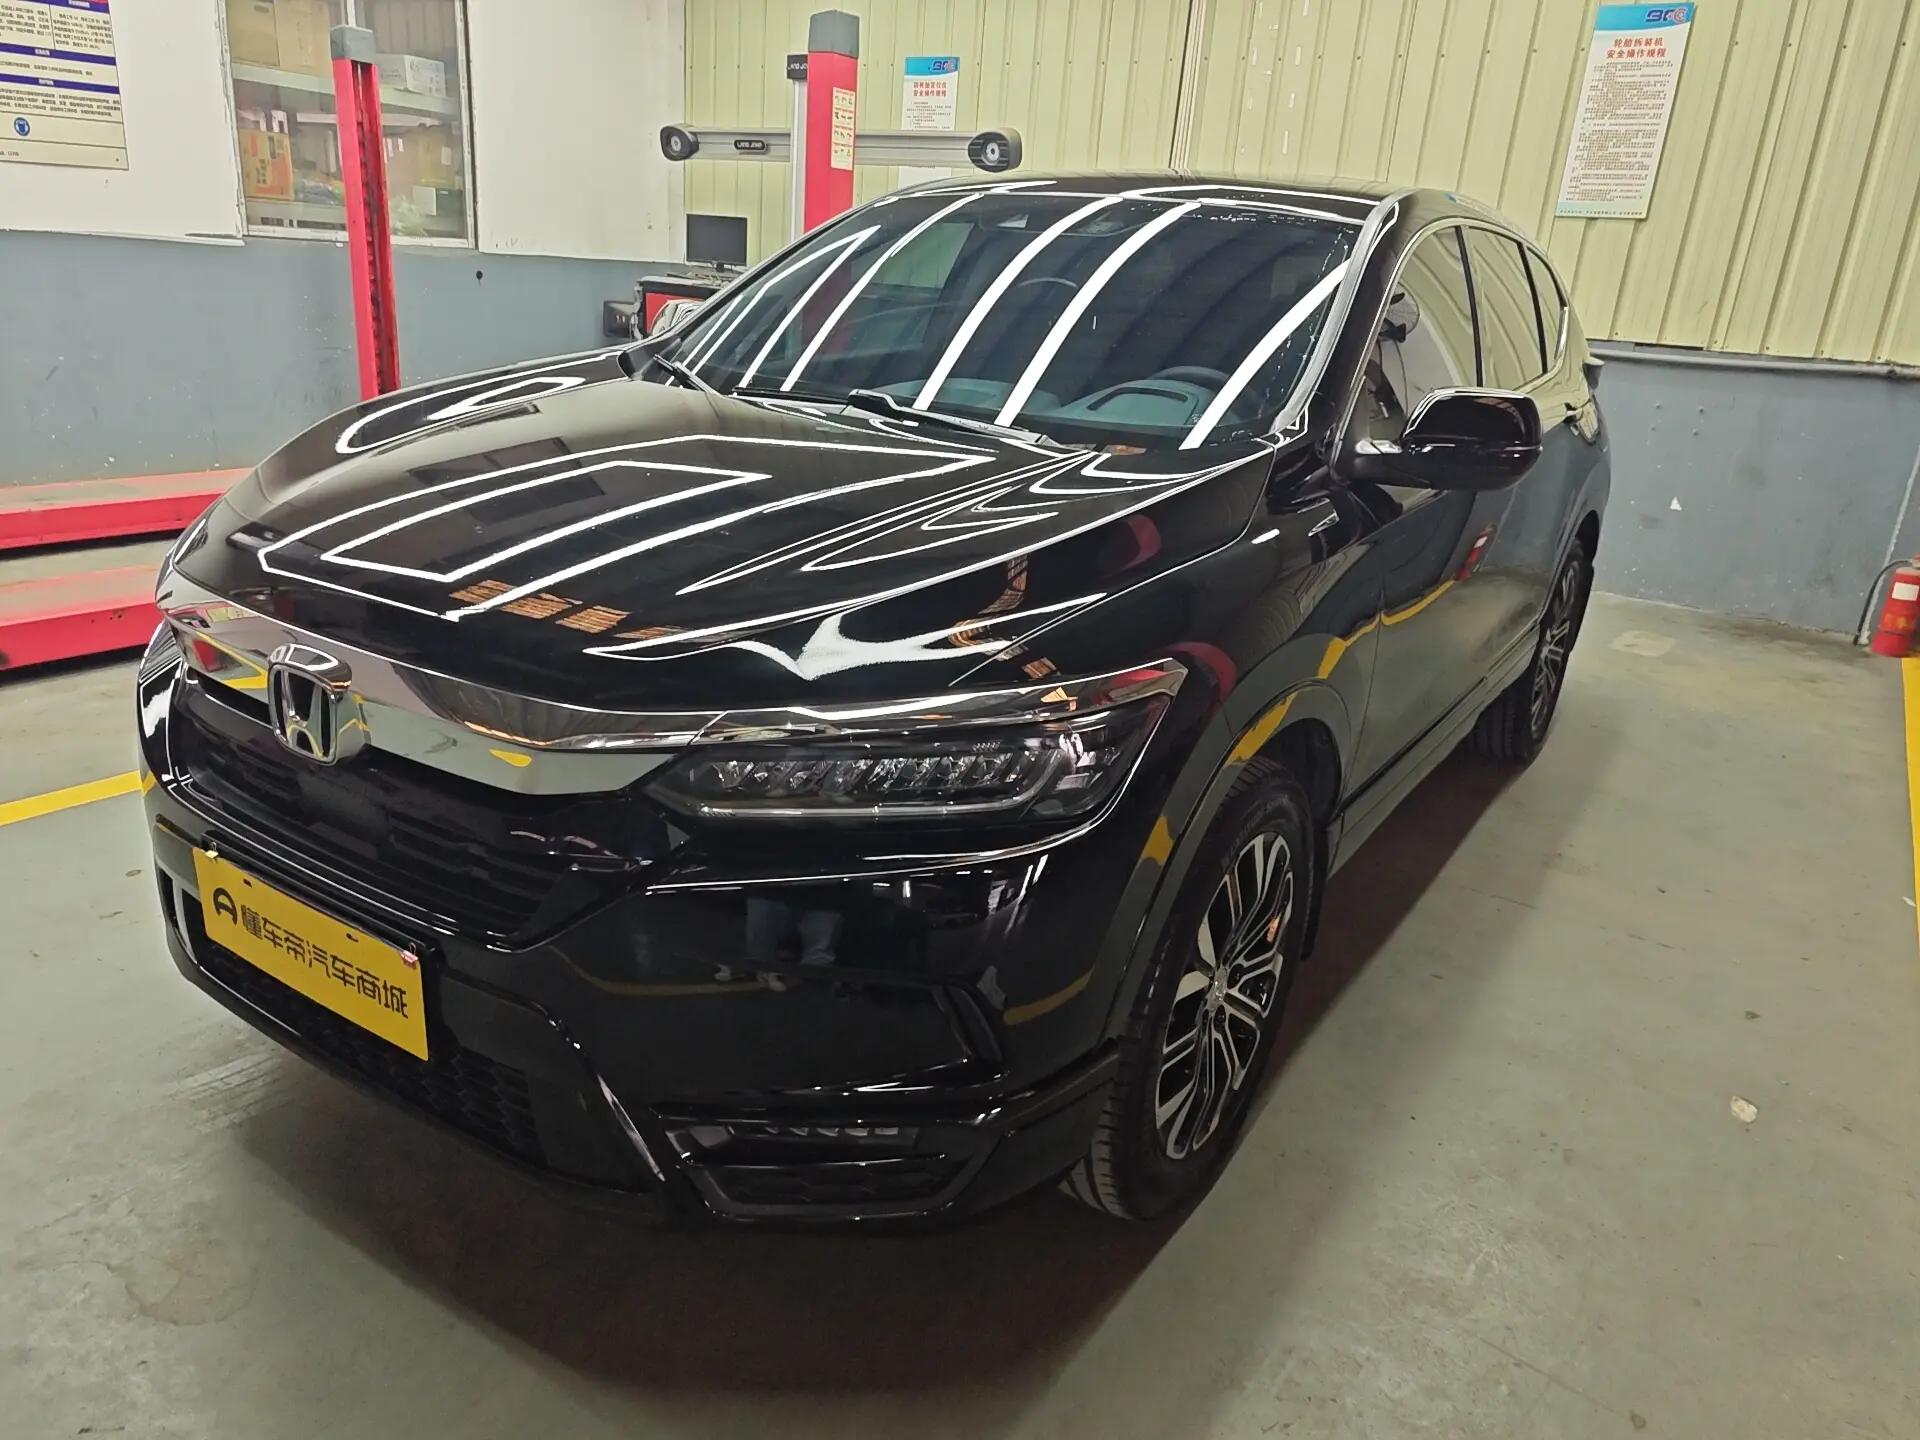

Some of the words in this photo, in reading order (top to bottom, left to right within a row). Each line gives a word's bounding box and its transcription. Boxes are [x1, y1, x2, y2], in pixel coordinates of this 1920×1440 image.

[1606, 48, 1667, 59] 安全操作规程
[241, 903, 409, 1019] 懂车帝汽车商城
